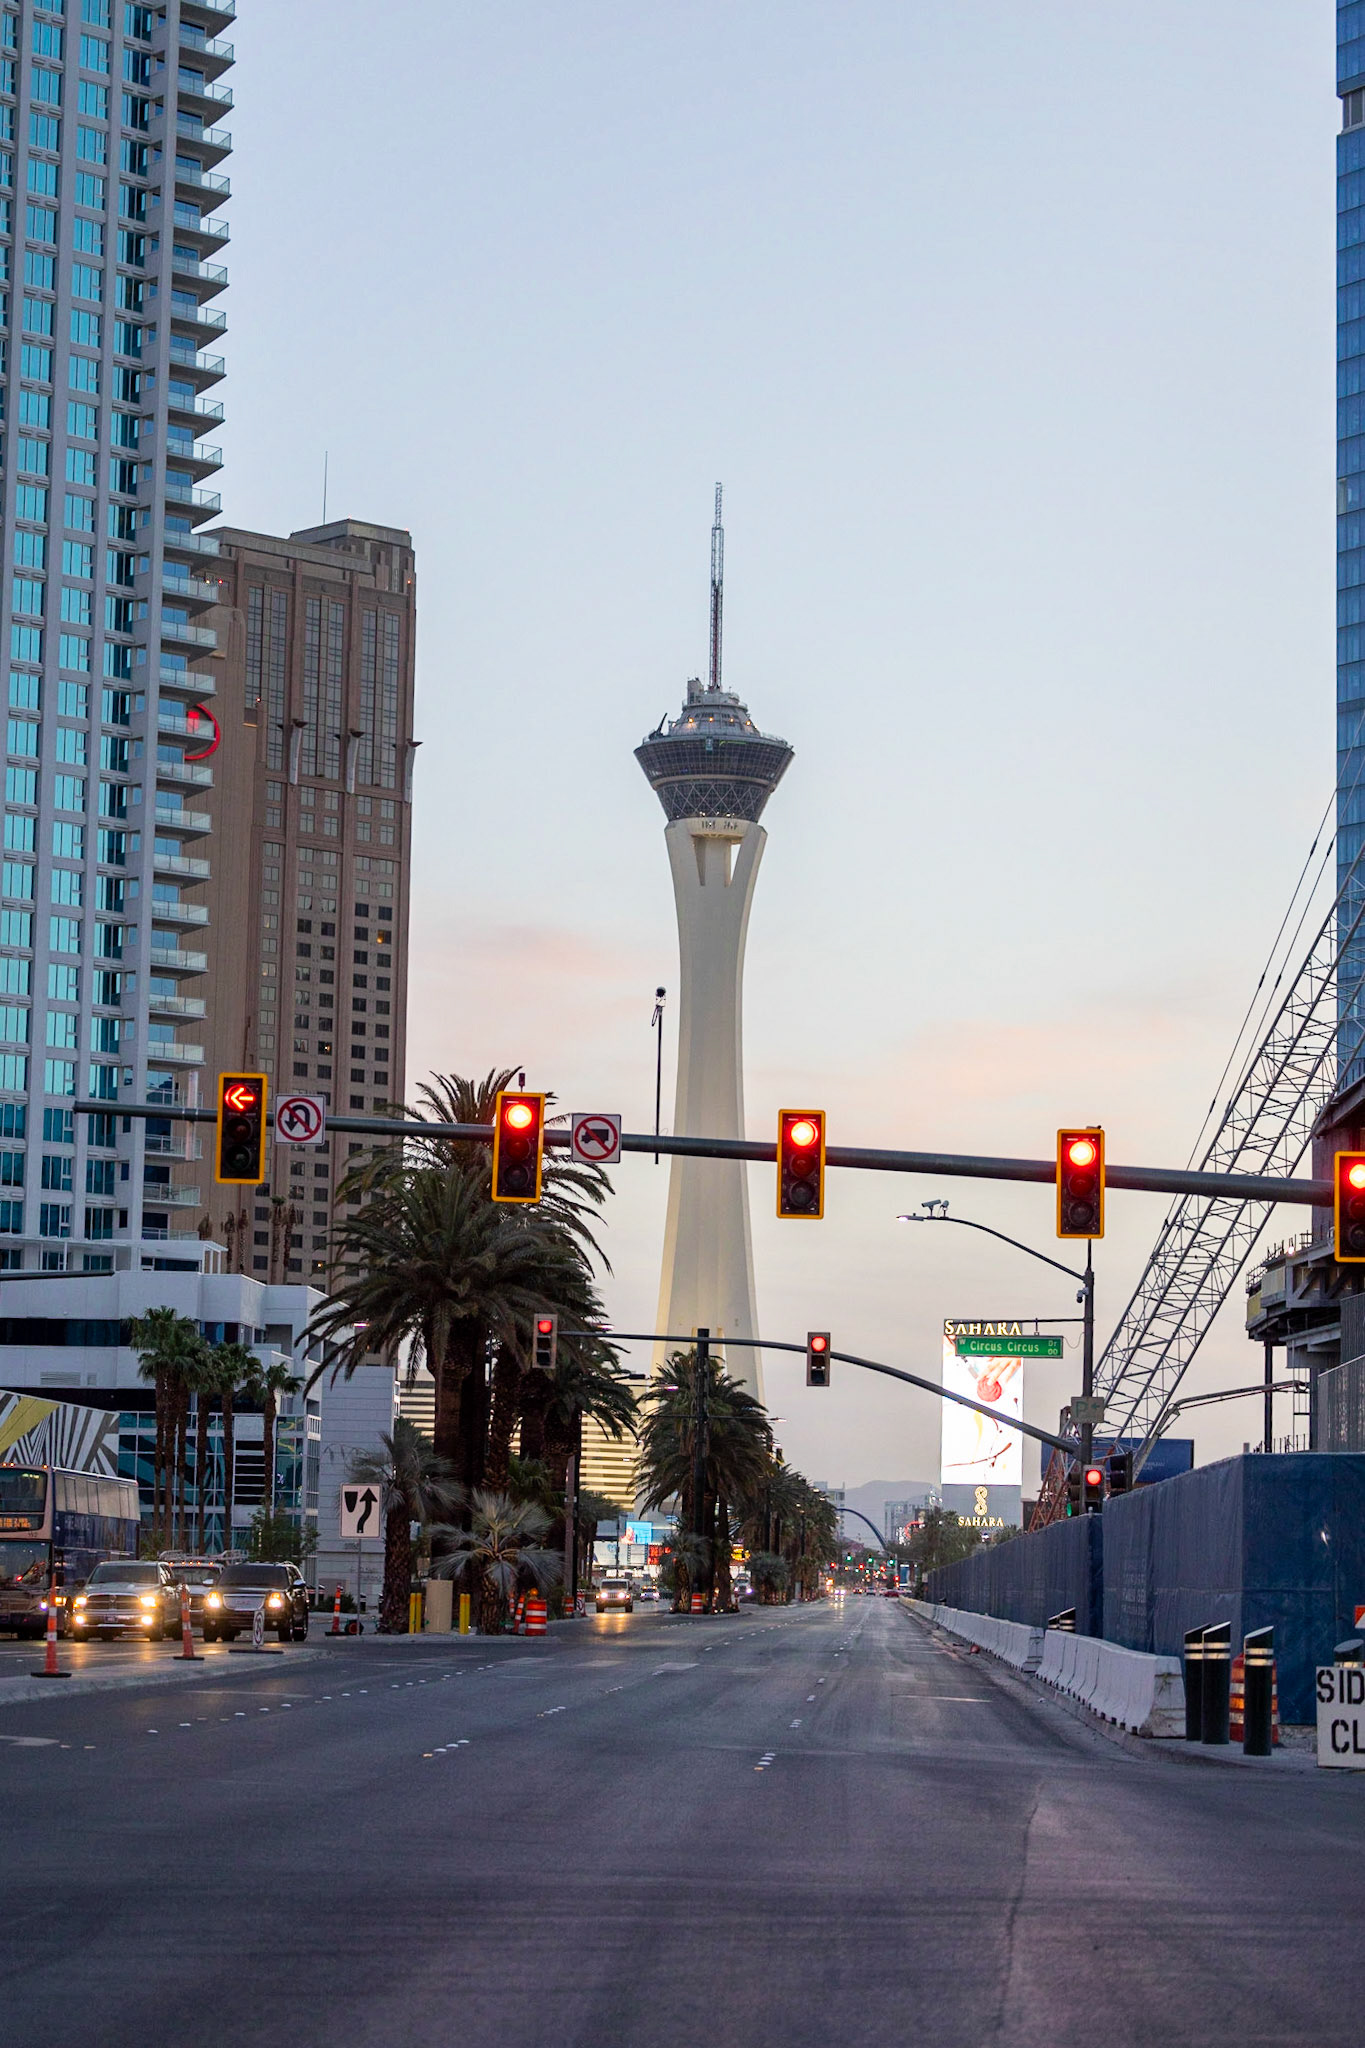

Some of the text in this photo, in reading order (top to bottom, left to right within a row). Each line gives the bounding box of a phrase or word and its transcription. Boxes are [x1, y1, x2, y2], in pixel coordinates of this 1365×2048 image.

[944, 1319, 1022, 1336] SAHARA
[970, 1341, 1002, 1352] Circus
[1007, 1342, 1039, 1353] Circus
[1076, 1401, 1088, 1417] P
[957, 1516, 1005, 1527] SAHARA
[1331, 1719, 1365, 1754] CL
